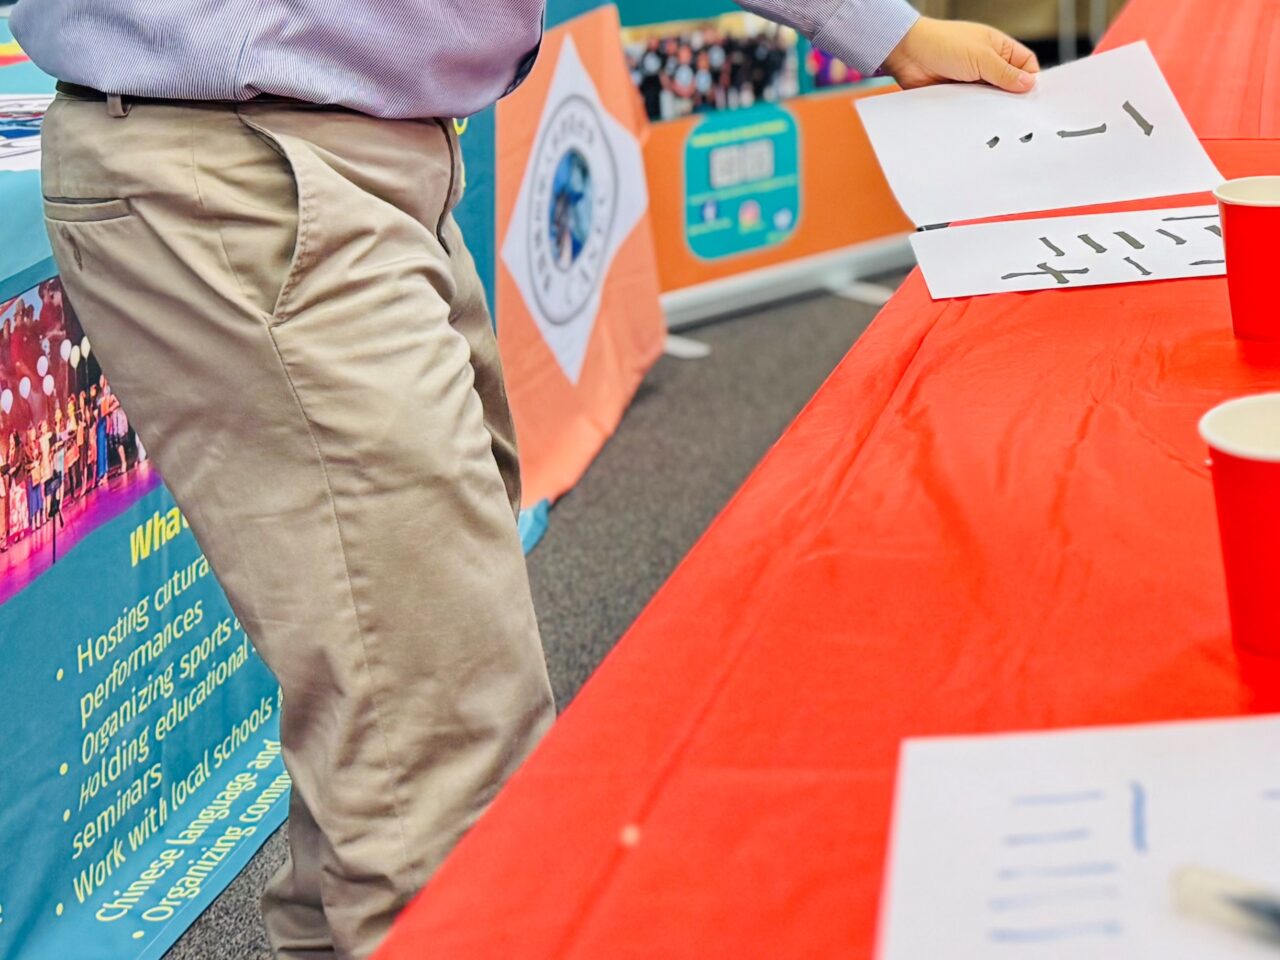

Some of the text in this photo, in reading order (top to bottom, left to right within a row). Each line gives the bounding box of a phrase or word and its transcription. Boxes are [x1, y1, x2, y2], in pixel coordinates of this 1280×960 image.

[130, 506, 190, 568] Wha
[77, 553, 209, 673] Hosting cutura
[80, 599, 203, 730] performances
[79, 633, 248, 813] Holding educational
[82, 617, 231, 765] Organizing sports
[73, 837, 126, 904] Work
[128, 797, 168, 852] with
[171, 748, 211, 811] local
[213, 696, 273, 769] schools
[73, 762, 162, 859] seminars
[95, 848, 185, 922] Chinese
[165, 771, 258, 845] language
[141, 770, 292, 922] Organizing comm
